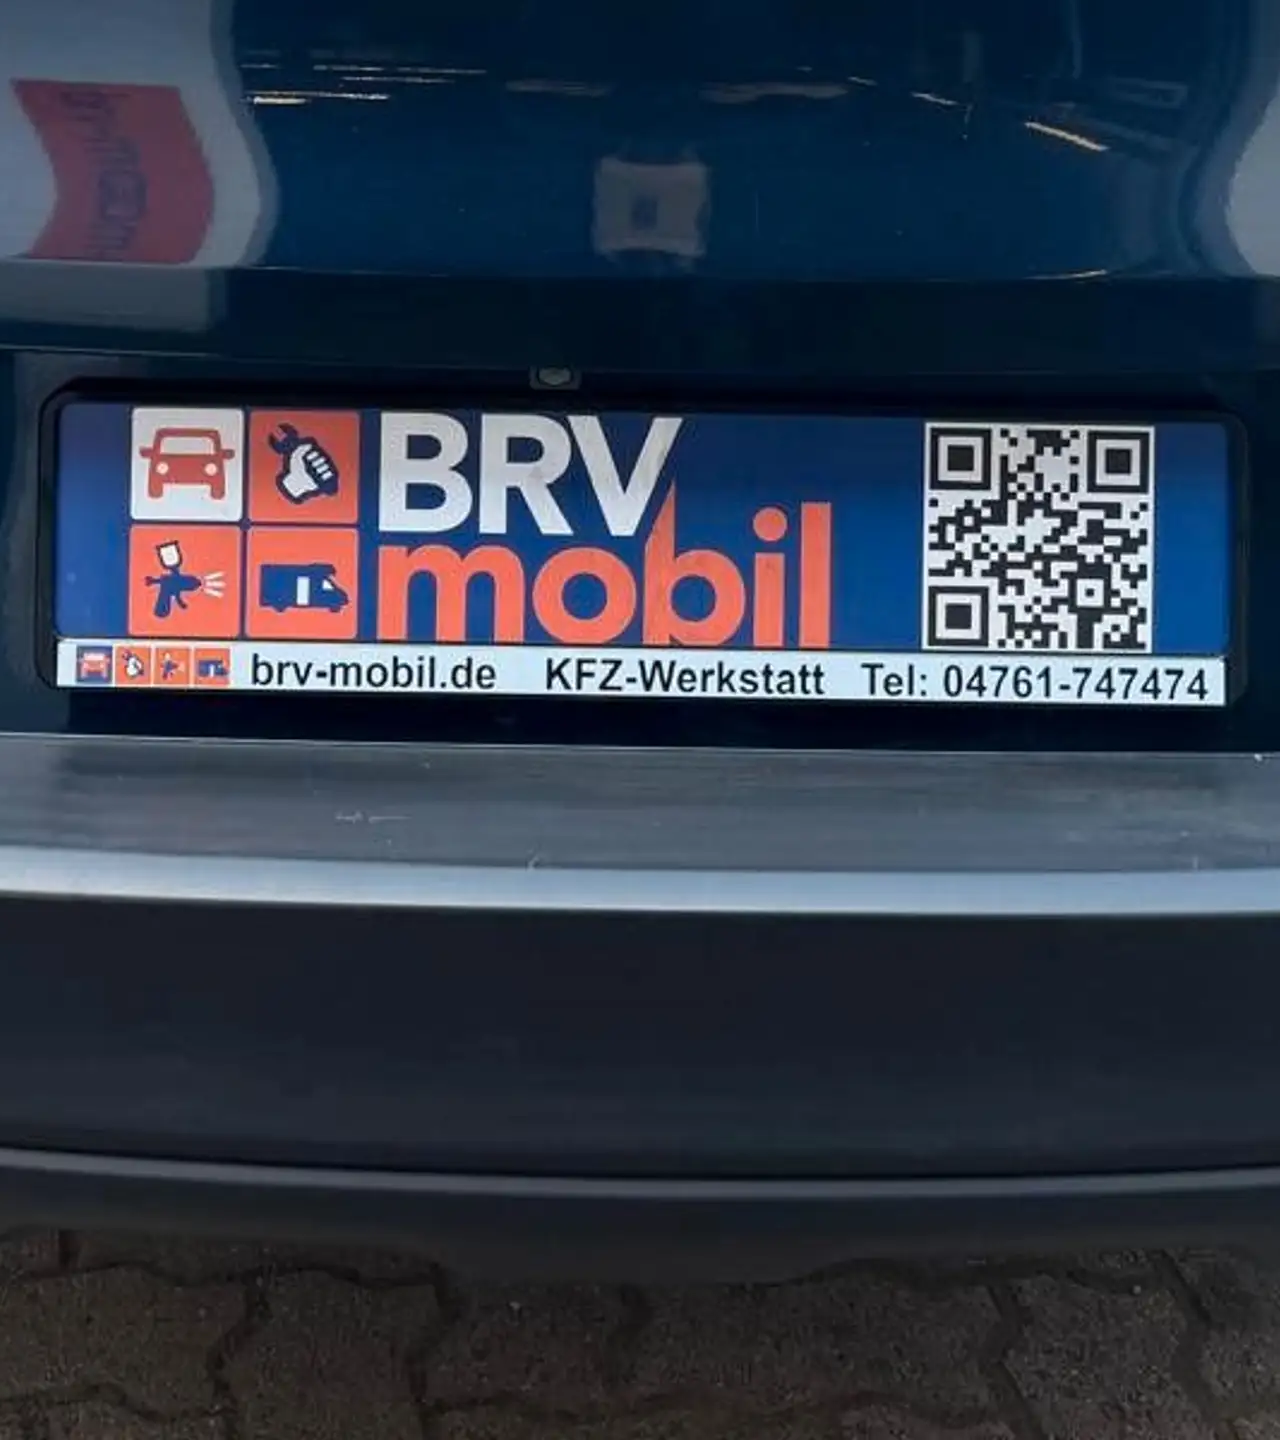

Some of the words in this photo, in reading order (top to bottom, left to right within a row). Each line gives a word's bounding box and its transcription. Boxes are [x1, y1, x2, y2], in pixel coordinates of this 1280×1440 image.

[378, 412, 683, 537] BRV
[376, 479, 832, 648] mobil
[250, 652, 497, 691] brv-mobil.de
[545, 657, 826, 696] KFZ-Werkstatt
[860, 662, 928, 698] Tel:
[942, 663, 1210, 701] 04761-747474
